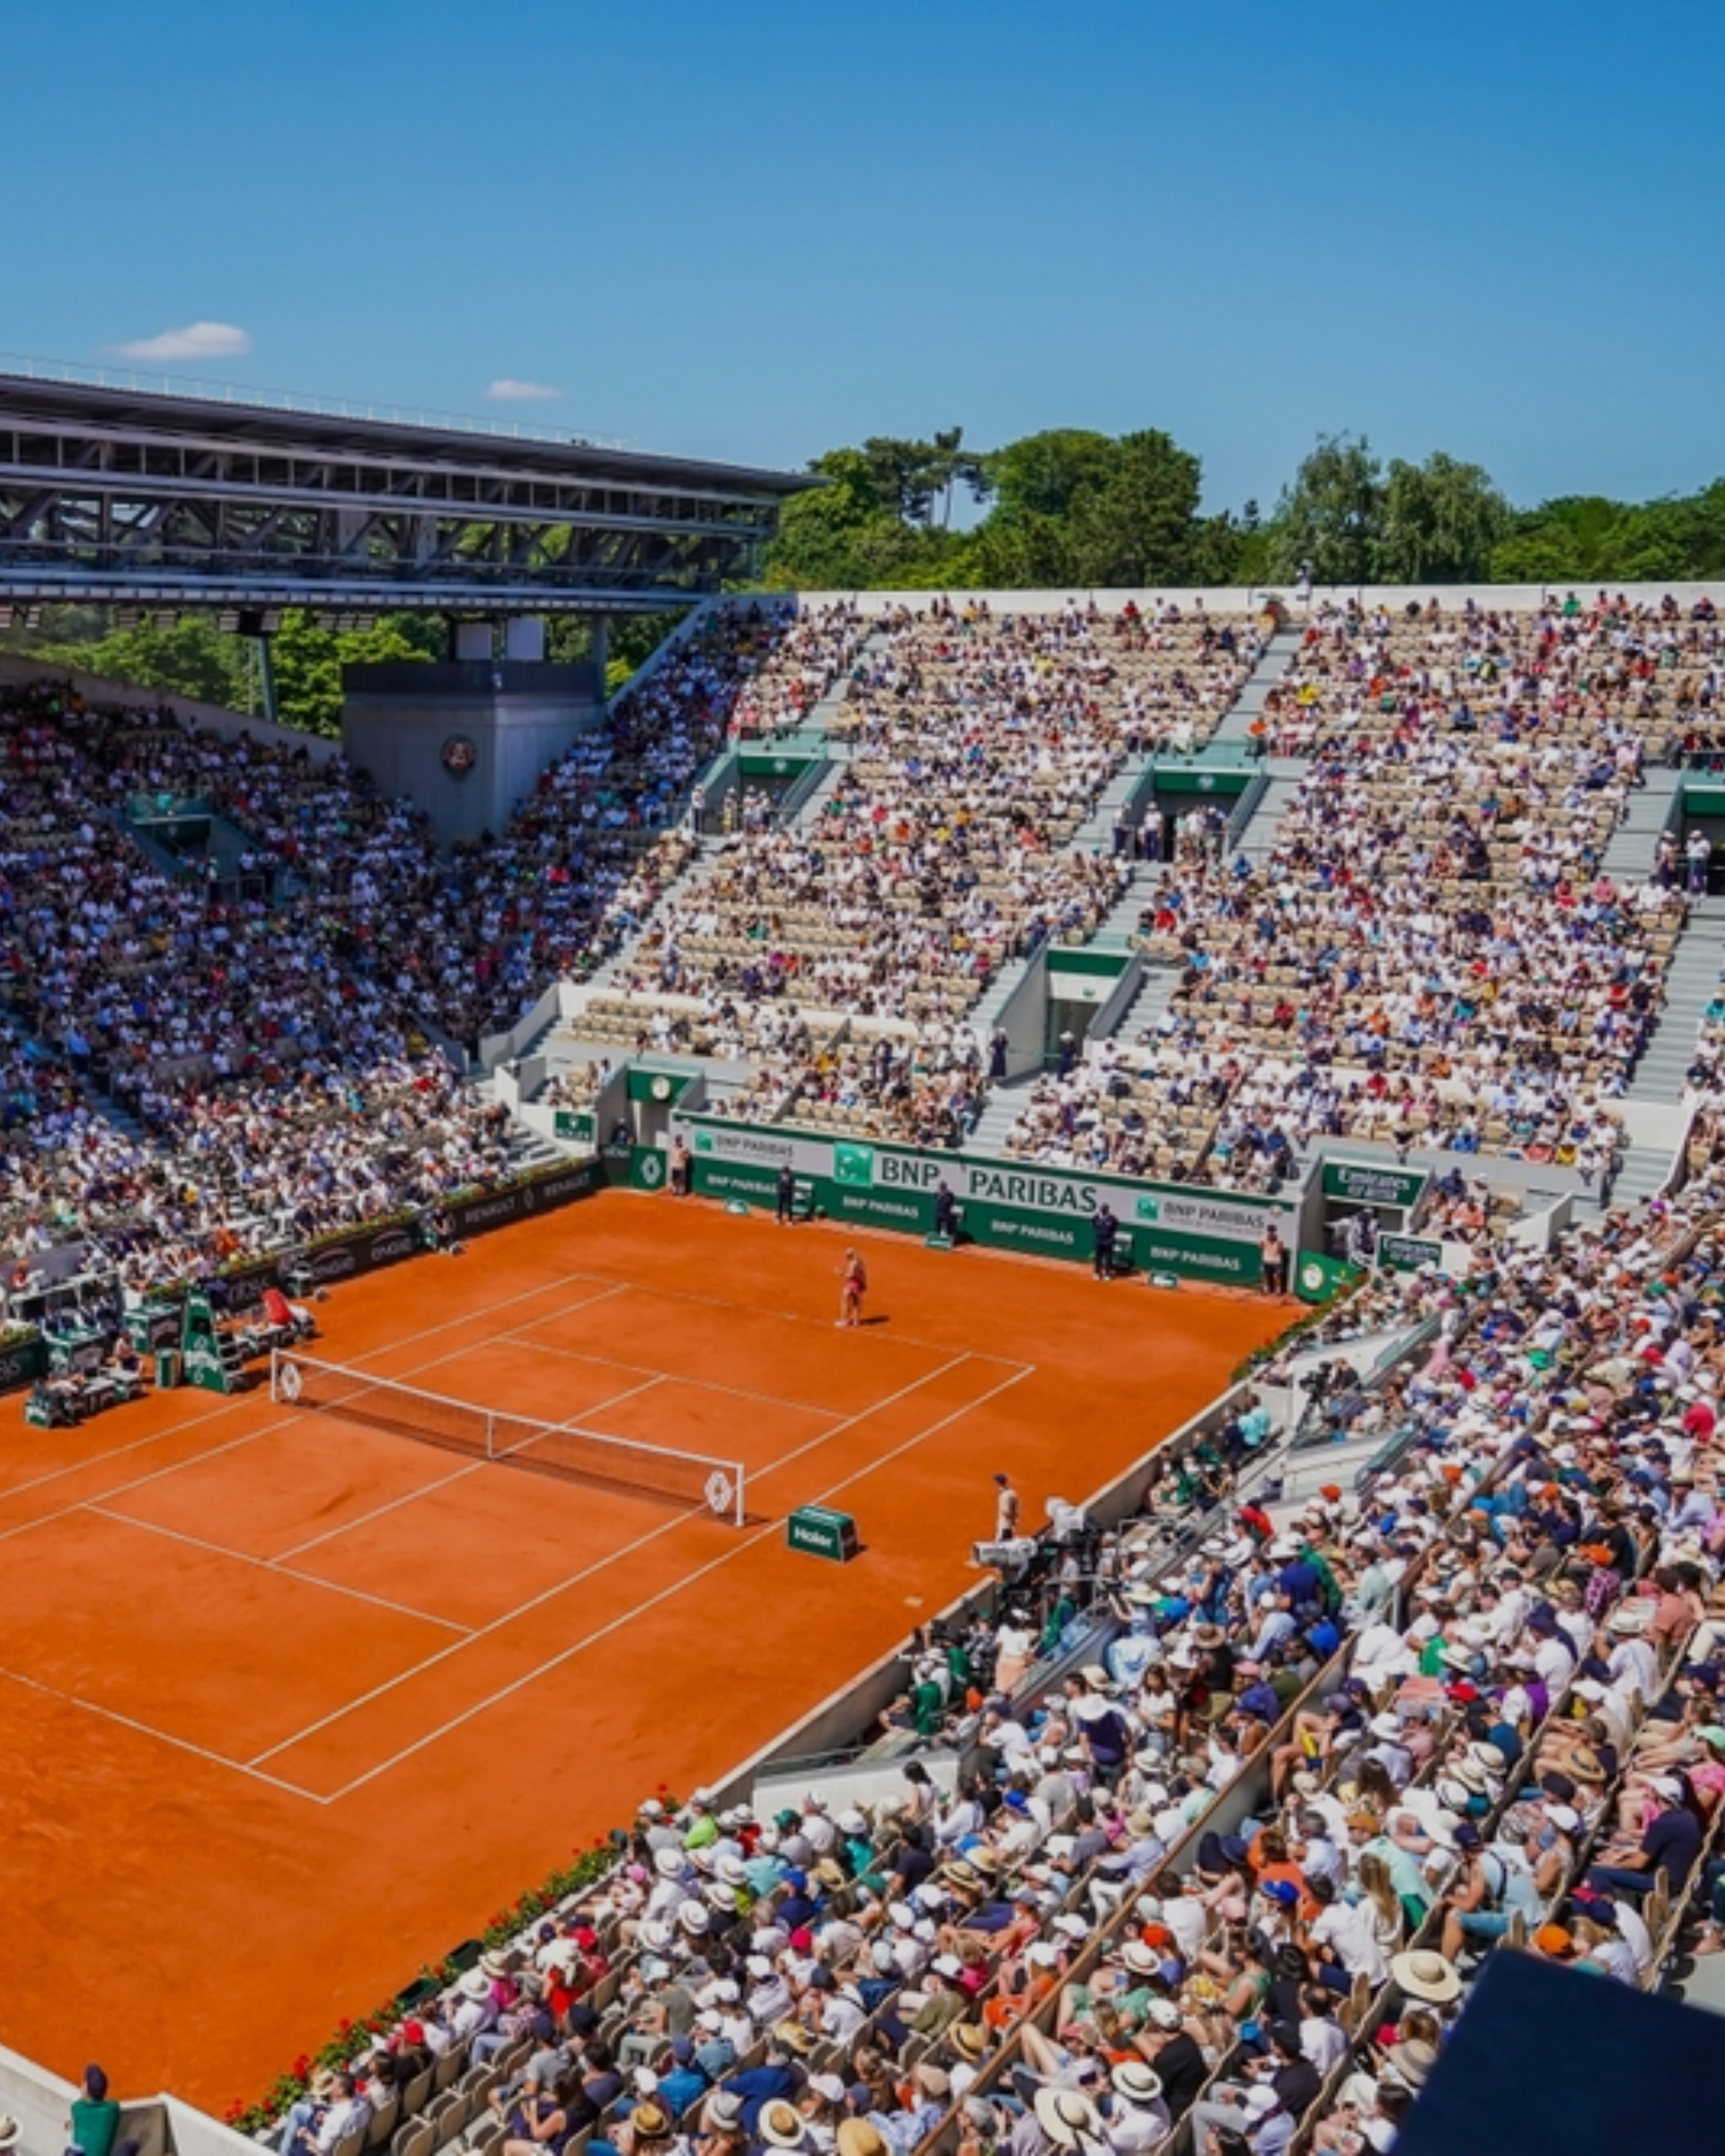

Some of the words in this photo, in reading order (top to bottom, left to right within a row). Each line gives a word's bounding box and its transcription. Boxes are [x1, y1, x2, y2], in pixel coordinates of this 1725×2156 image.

[882, 1157, 941, 1187] BNP
[969, 1170, 1097, 1213] PARIBAS
[1338, 1168, 1411, 1190] Emirates
[1164, 1202, 1197, 1216] BNP
[1199, 1206, 1265, 1228] PARIBAS
